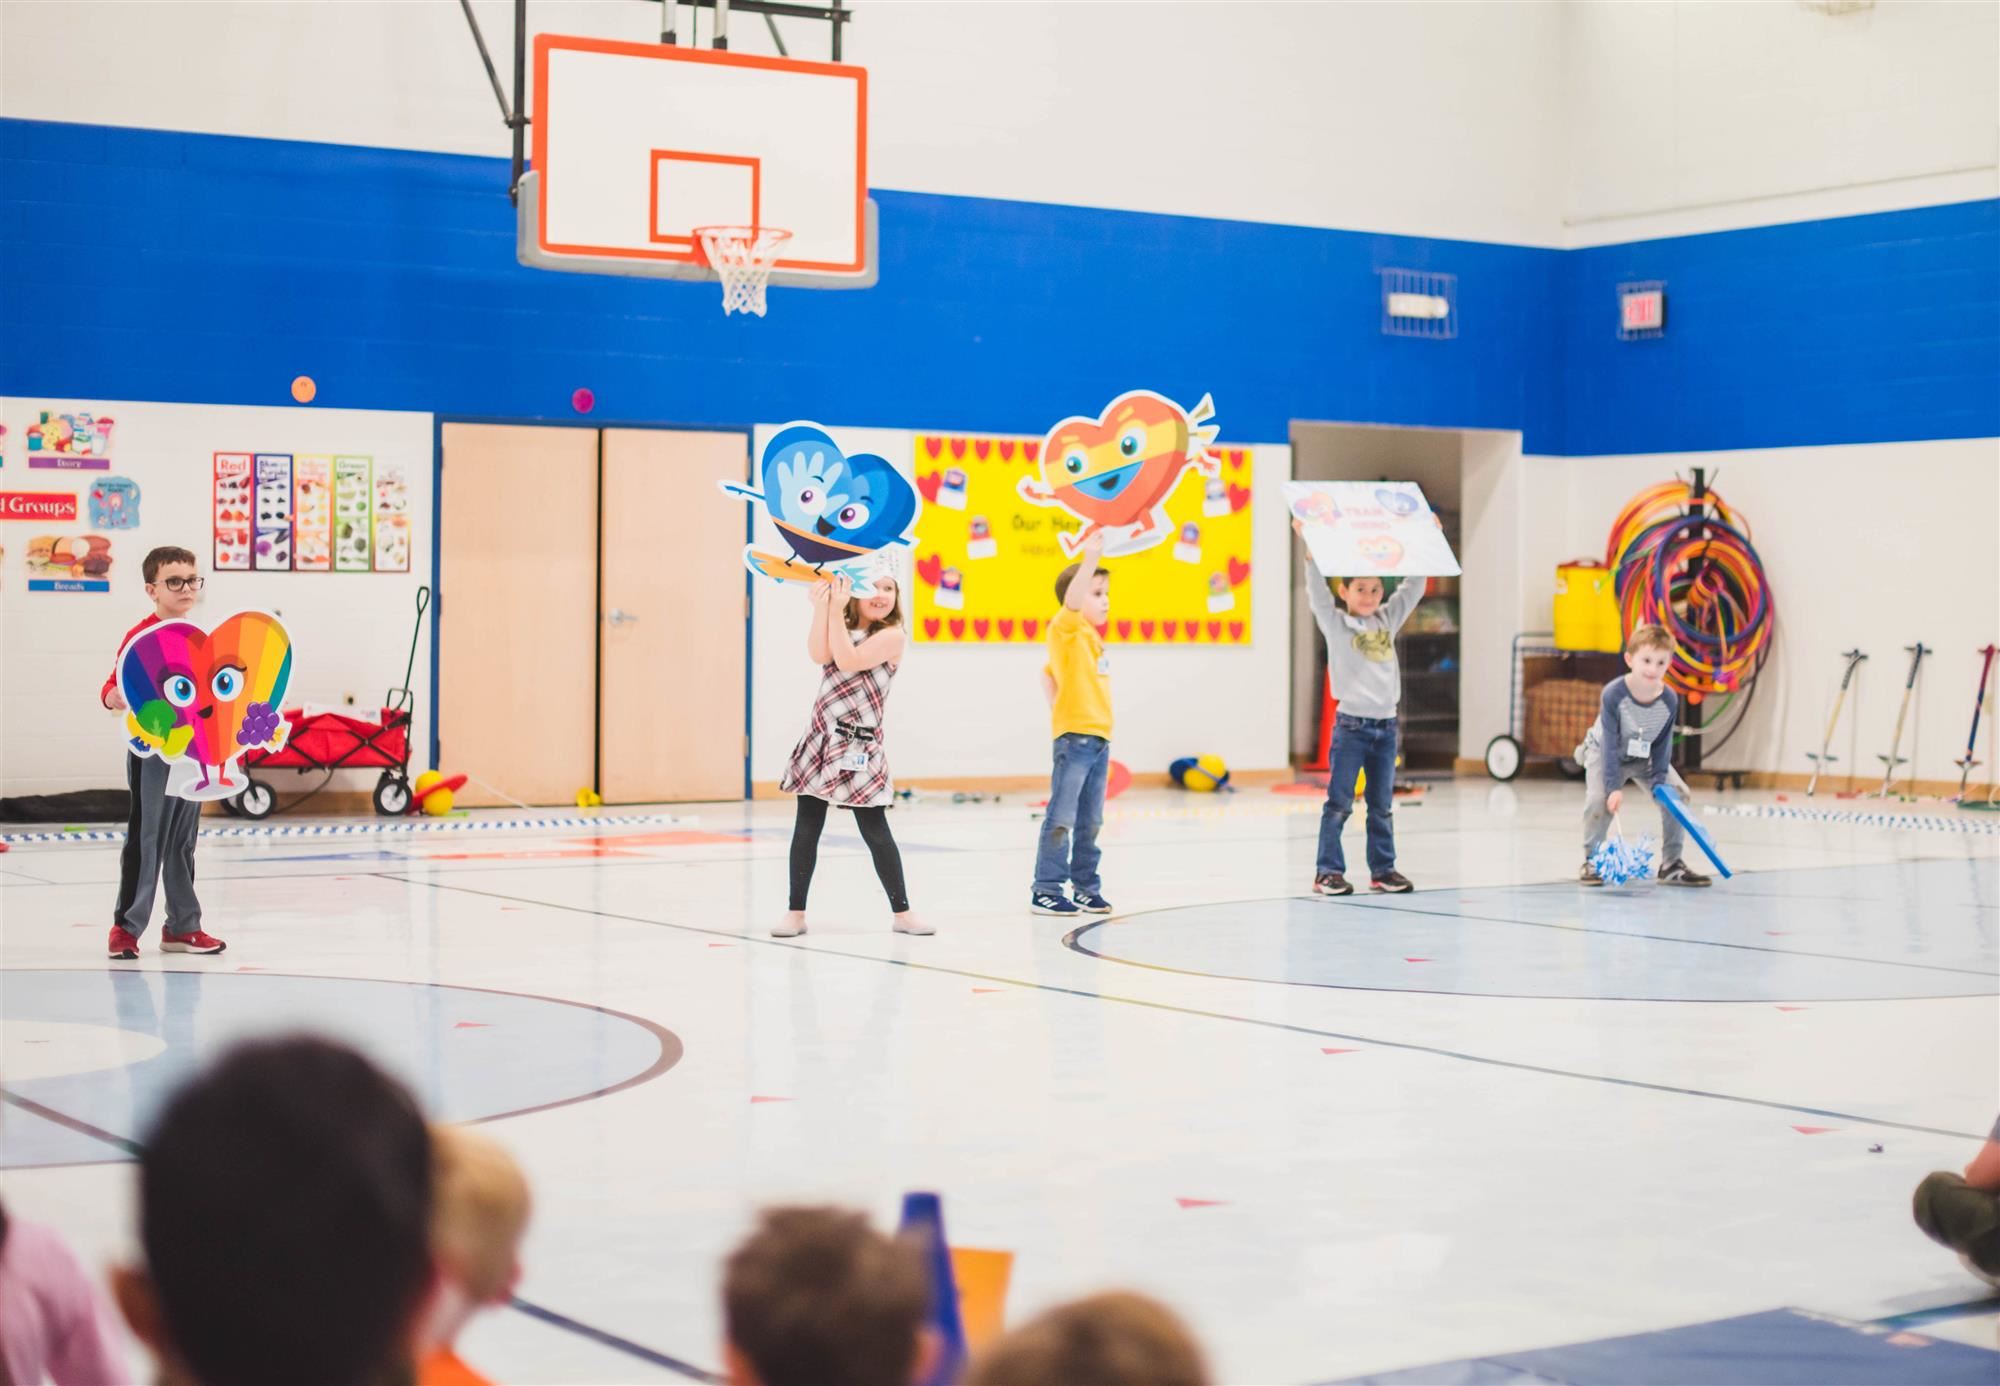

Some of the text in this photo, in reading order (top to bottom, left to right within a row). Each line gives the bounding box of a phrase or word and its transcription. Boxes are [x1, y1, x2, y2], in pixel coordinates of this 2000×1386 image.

[221, 459, 246, 471] Red
[9, 496, 75, 517] Groups
[1012, 514, 1041, 531] Our
